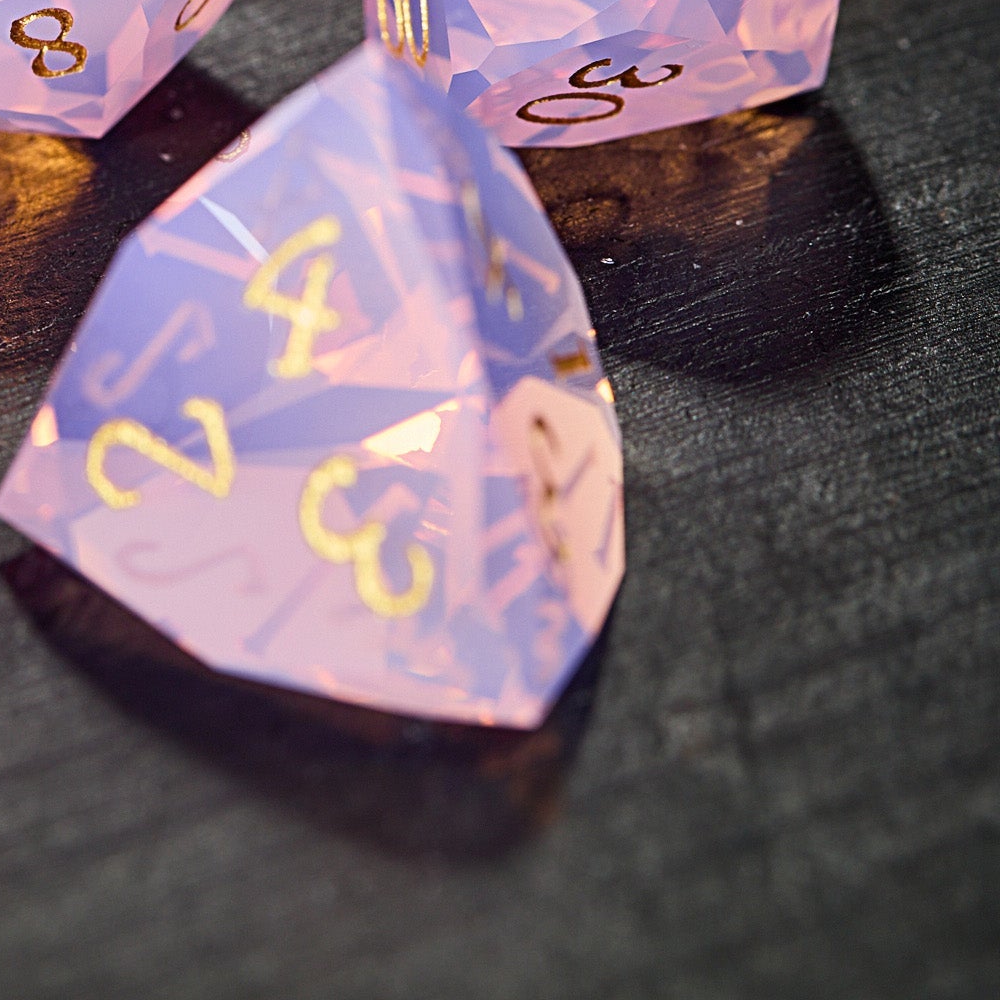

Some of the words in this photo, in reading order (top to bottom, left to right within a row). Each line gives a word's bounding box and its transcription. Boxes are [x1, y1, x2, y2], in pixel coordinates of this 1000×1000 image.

[10, 7, 88, 79] 8
[516, 58, 684, 126] 30
[243, 215, 345, 380] 4
[85, 397, 236, 512] 2
[299, 454, 436, 620] 3
